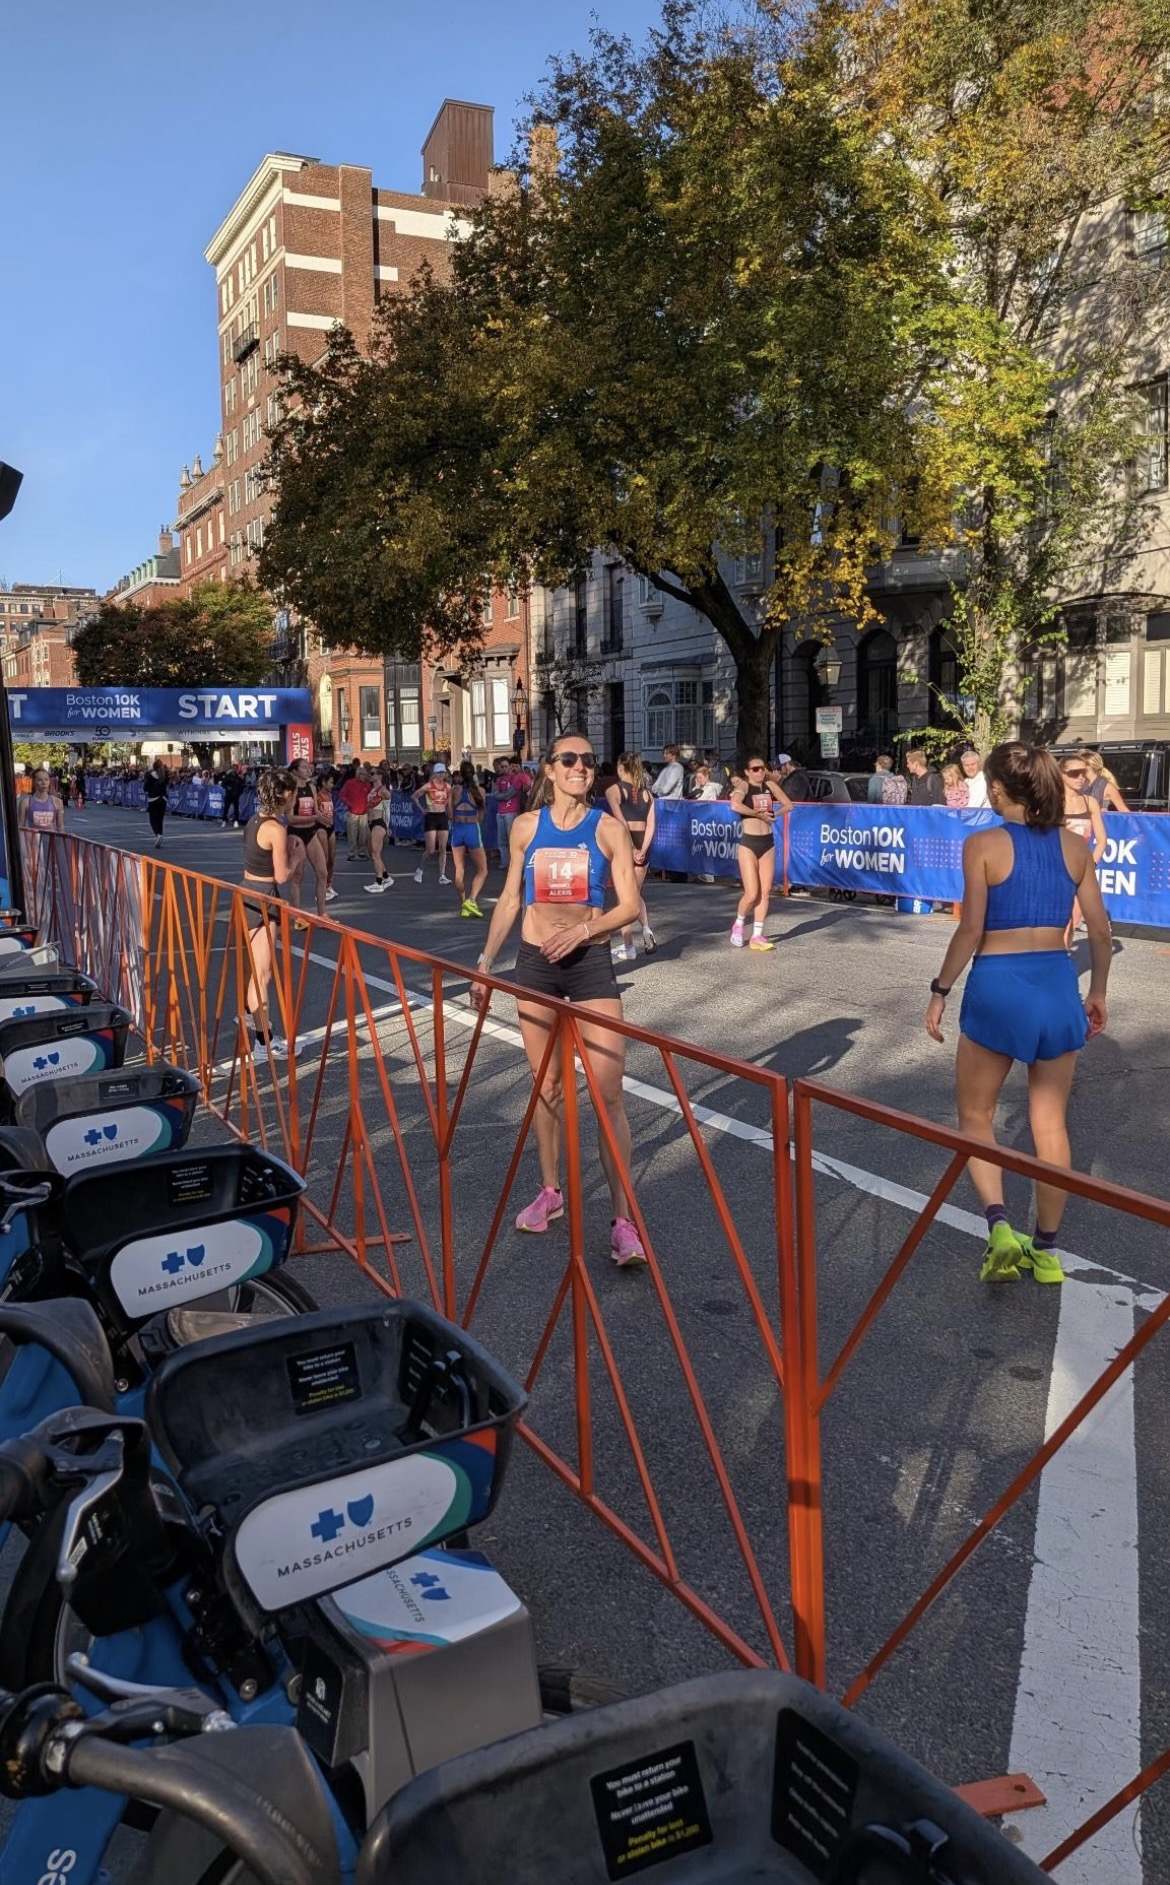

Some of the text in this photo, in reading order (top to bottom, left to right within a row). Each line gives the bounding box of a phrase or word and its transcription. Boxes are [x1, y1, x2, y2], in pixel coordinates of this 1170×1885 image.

[67, 707, 141, 719] for WOMEN
[178, 694, 277, 719] START
[703, 840, 739, 860] WOM
[820, 848, 905, 874] for WOMEN
[549, 862, 573, 880] 14
[21, 1062, 79, 1083] MASSACHUSETTS
[67, 1138, 139, 1162] MASSACHUSETTS
[138, 1262, 232, 1296] MASSACHUSETTS
[277, 1516, 413, 1578] MASSACHUSETTS
[386, 1569, 425, 1622] SSACHUSETTS
[634, 1782, 643, 1791] to
[649, 1770, 676, 1785] station
